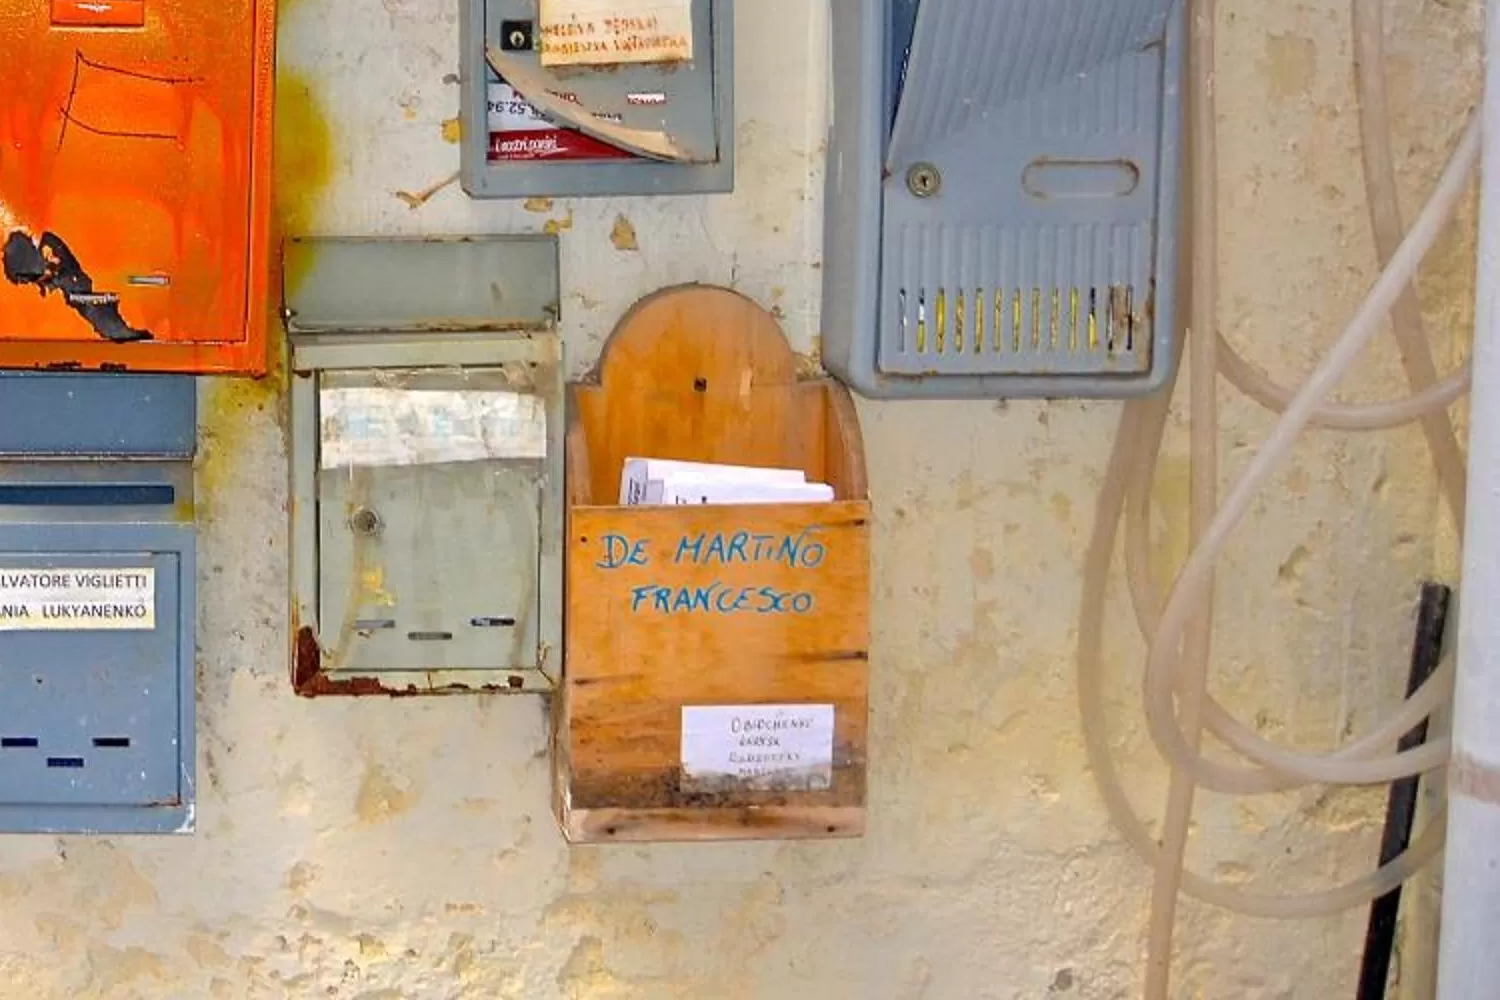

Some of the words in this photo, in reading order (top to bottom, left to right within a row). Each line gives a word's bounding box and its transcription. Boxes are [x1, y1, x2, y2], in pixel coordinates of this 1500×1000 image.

[596, 533, 651, 569] DE
[75, 573, 148, 589] VIGLIETTI
[631, 580, 813, 614] FRANCESCO
[41, 602, 148, 619] LUKYANENKO
